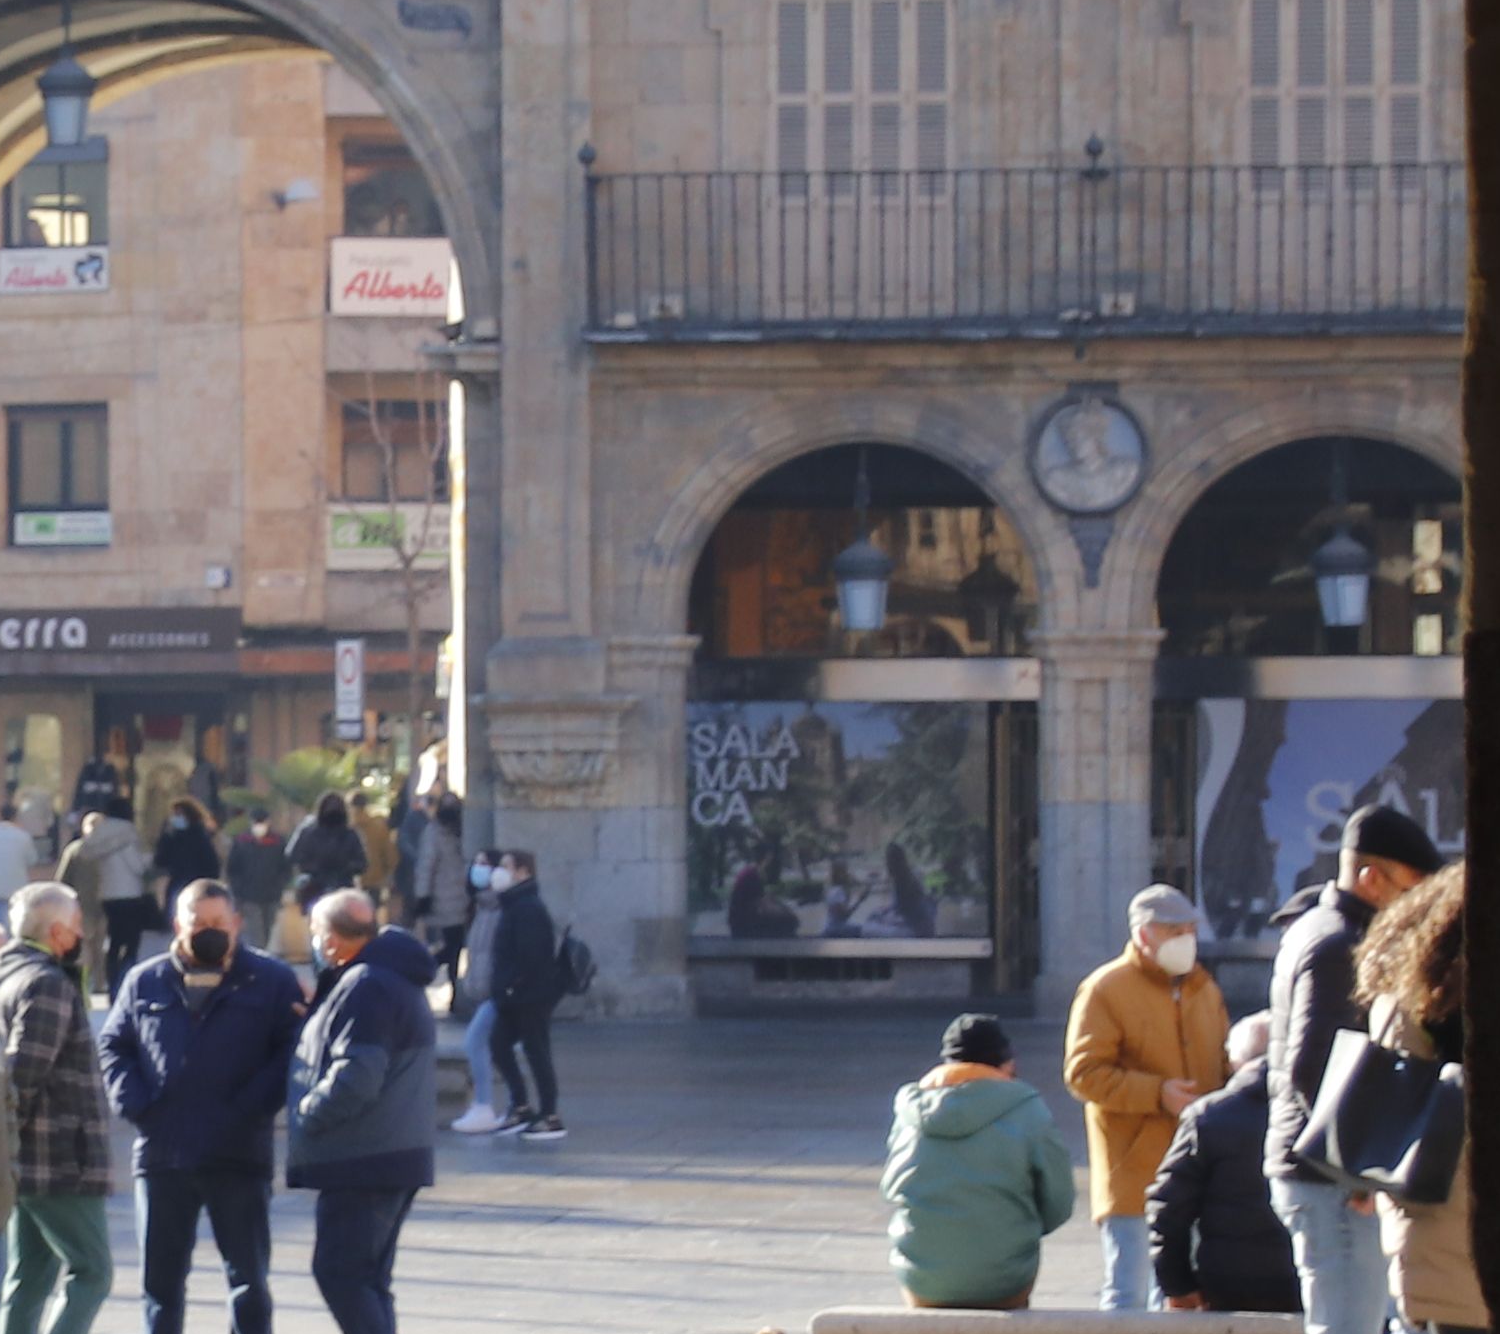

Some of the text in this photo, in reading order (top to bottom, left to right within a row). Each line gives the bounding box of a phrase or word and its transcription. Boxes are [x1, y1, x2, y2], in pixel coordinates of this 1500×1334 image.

[343, 270, 445, 300] Alberto
[693, 724, 800, 758] SALA
[697, 759, 790, 792] MAN
[691, 790, 754, 827] CA
